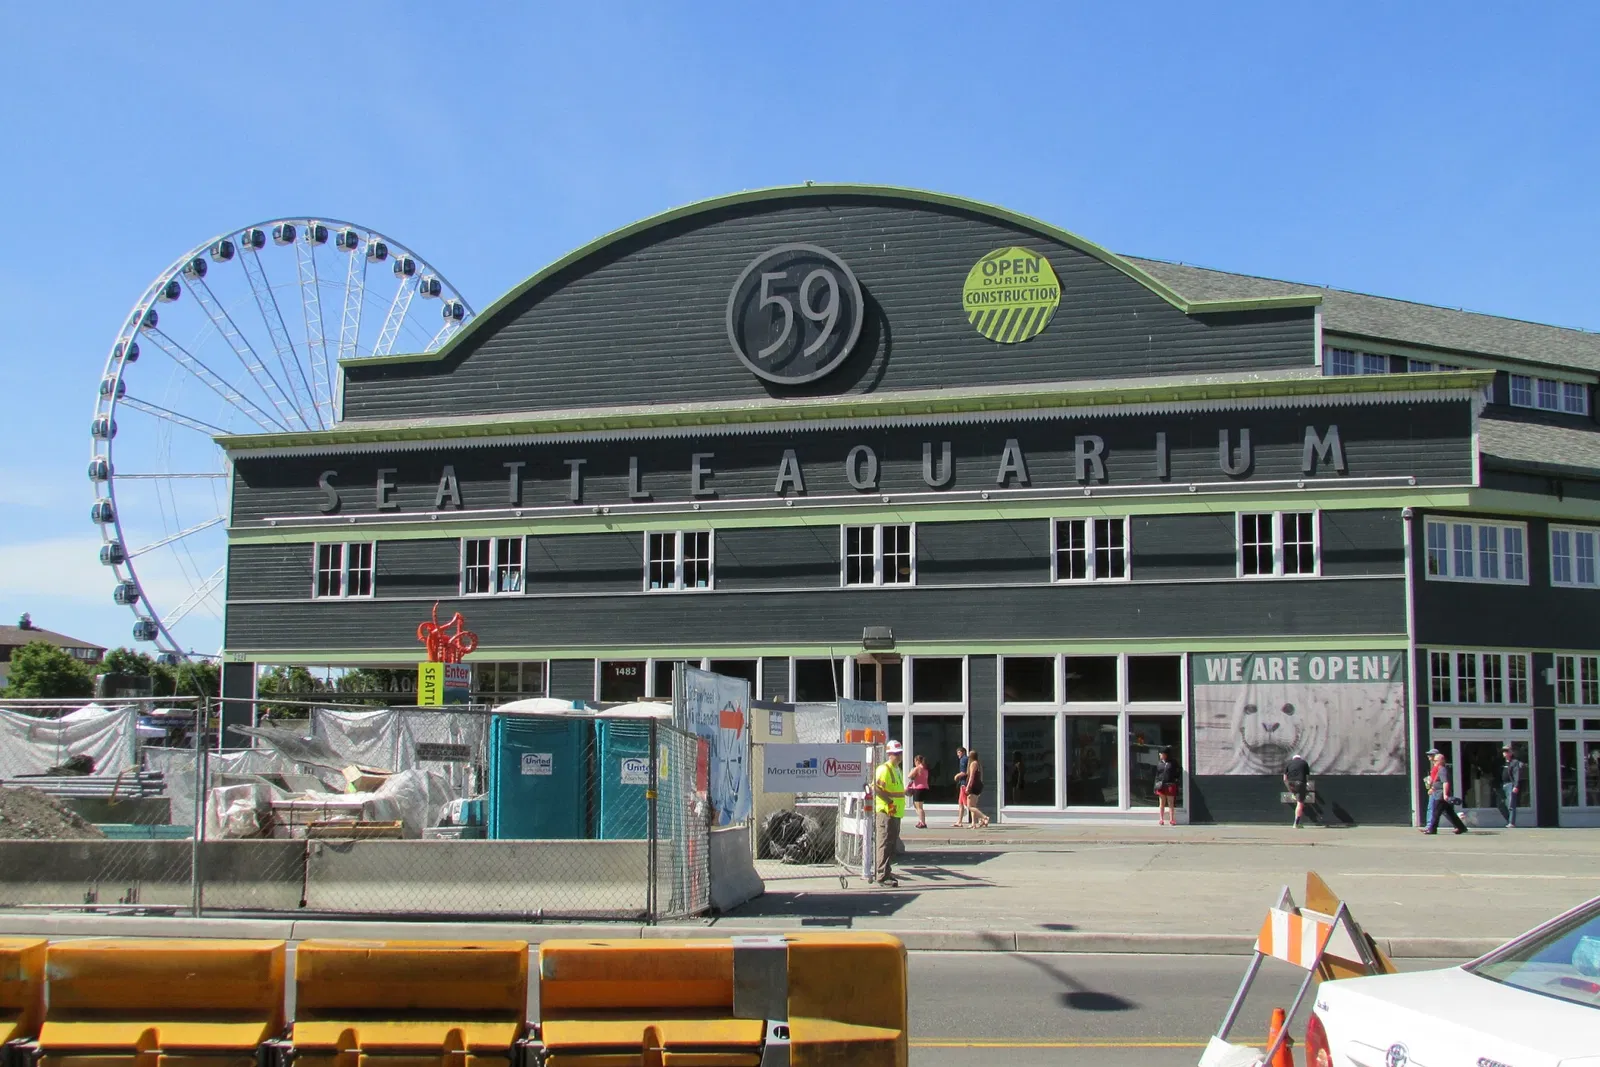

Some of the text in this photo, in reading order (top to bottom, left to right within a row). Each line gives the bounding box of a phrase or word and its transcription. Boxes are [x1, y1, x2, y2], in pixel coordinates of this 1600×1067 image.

[982, 258, 1040, 276] OPEN
[983, 275, 1039, 285] DURING
[966, 288, 1057, 304] CONSTRUCTION
[758, 268, 840, 359] 59
[318, 424, 1347, 512] SEATTLE AQUARIUM
[445, 664, 468, 678] Enter
[615, 667, 637, 675] 1483
[1205, 656, 1390, 681] WE ARE OPEN!
[526, 757, 551, 765] United
[826, 760, 860, 773] MANSON
[767, 767, 818, 775] Mortenson
